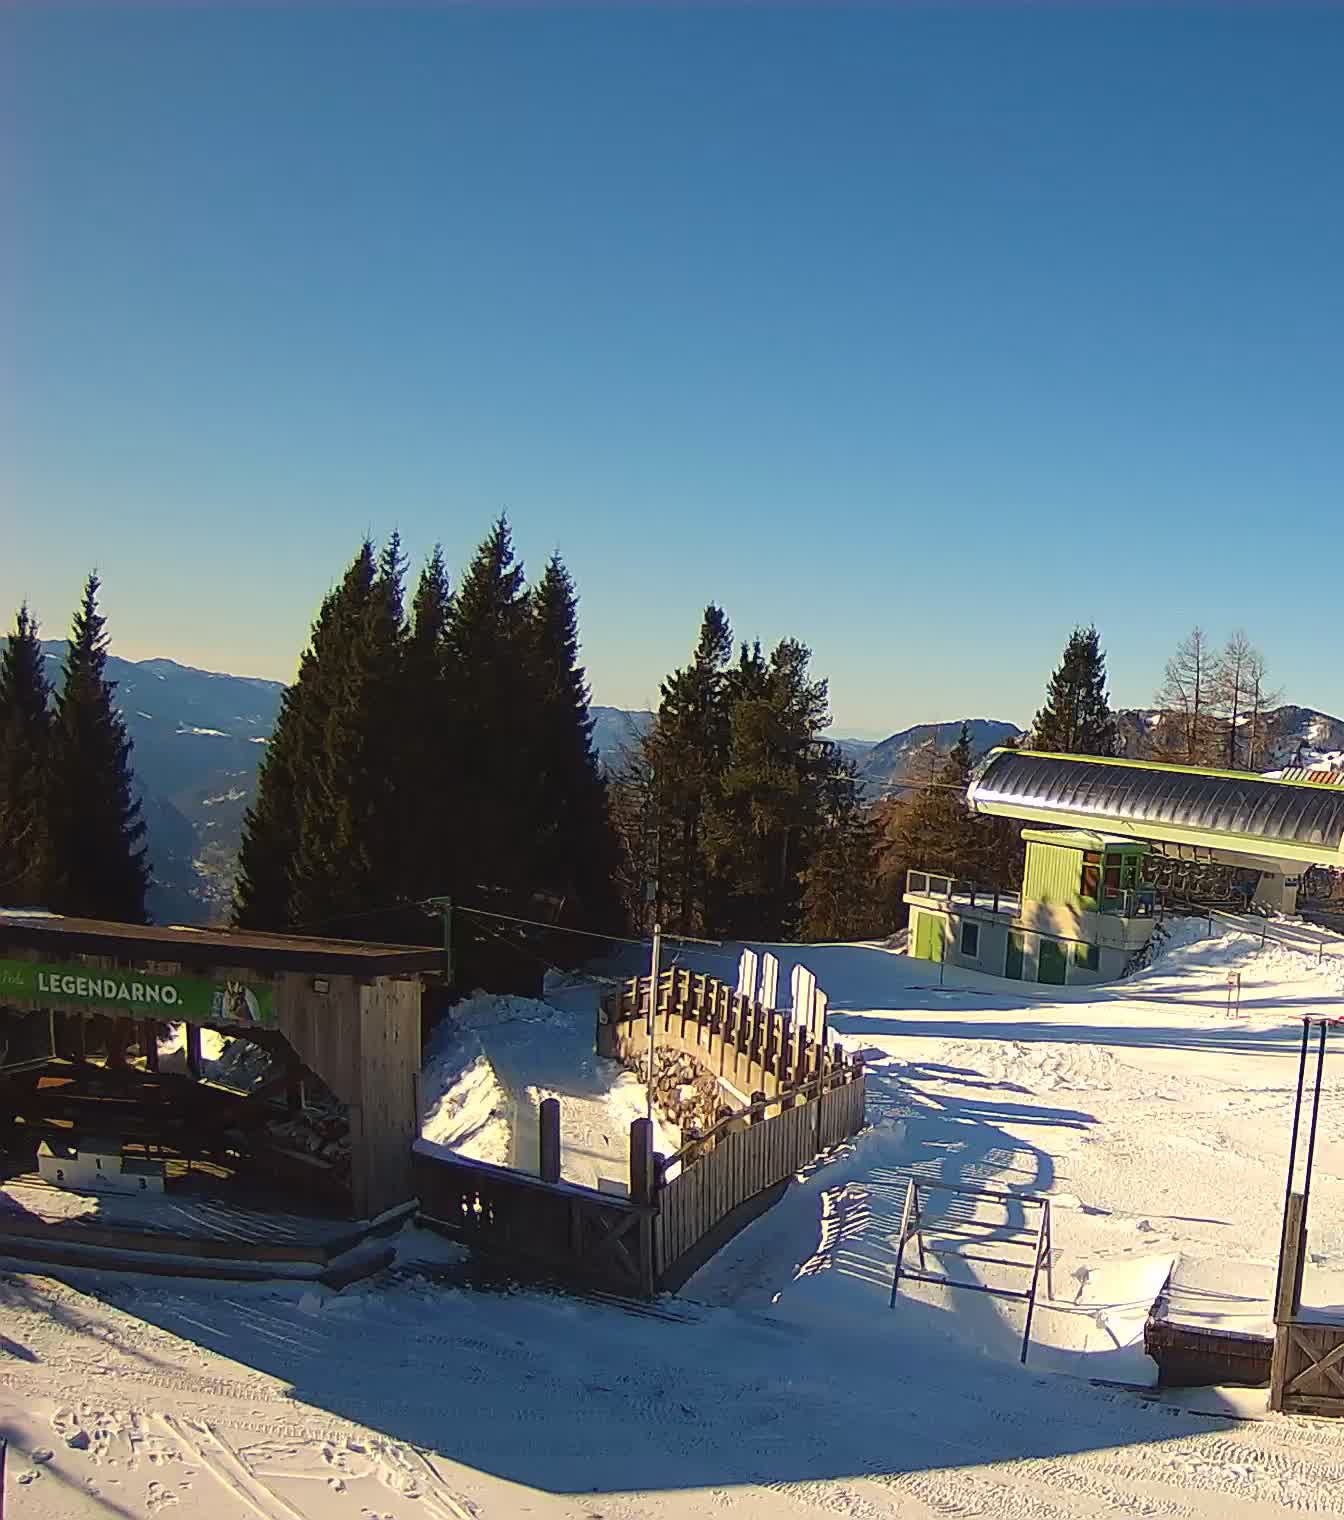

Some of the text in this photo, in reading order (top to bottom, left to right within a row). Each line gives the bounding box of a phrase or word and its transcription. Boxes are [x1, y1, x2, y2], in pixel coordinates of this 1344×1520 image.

[38, 973, 183, 1005] LEGENDARNO.
[95, 1158, 102, 1170] 1
[56, 1169, 65, 1181] 2
[138, 1178, 147, 1190] 3
